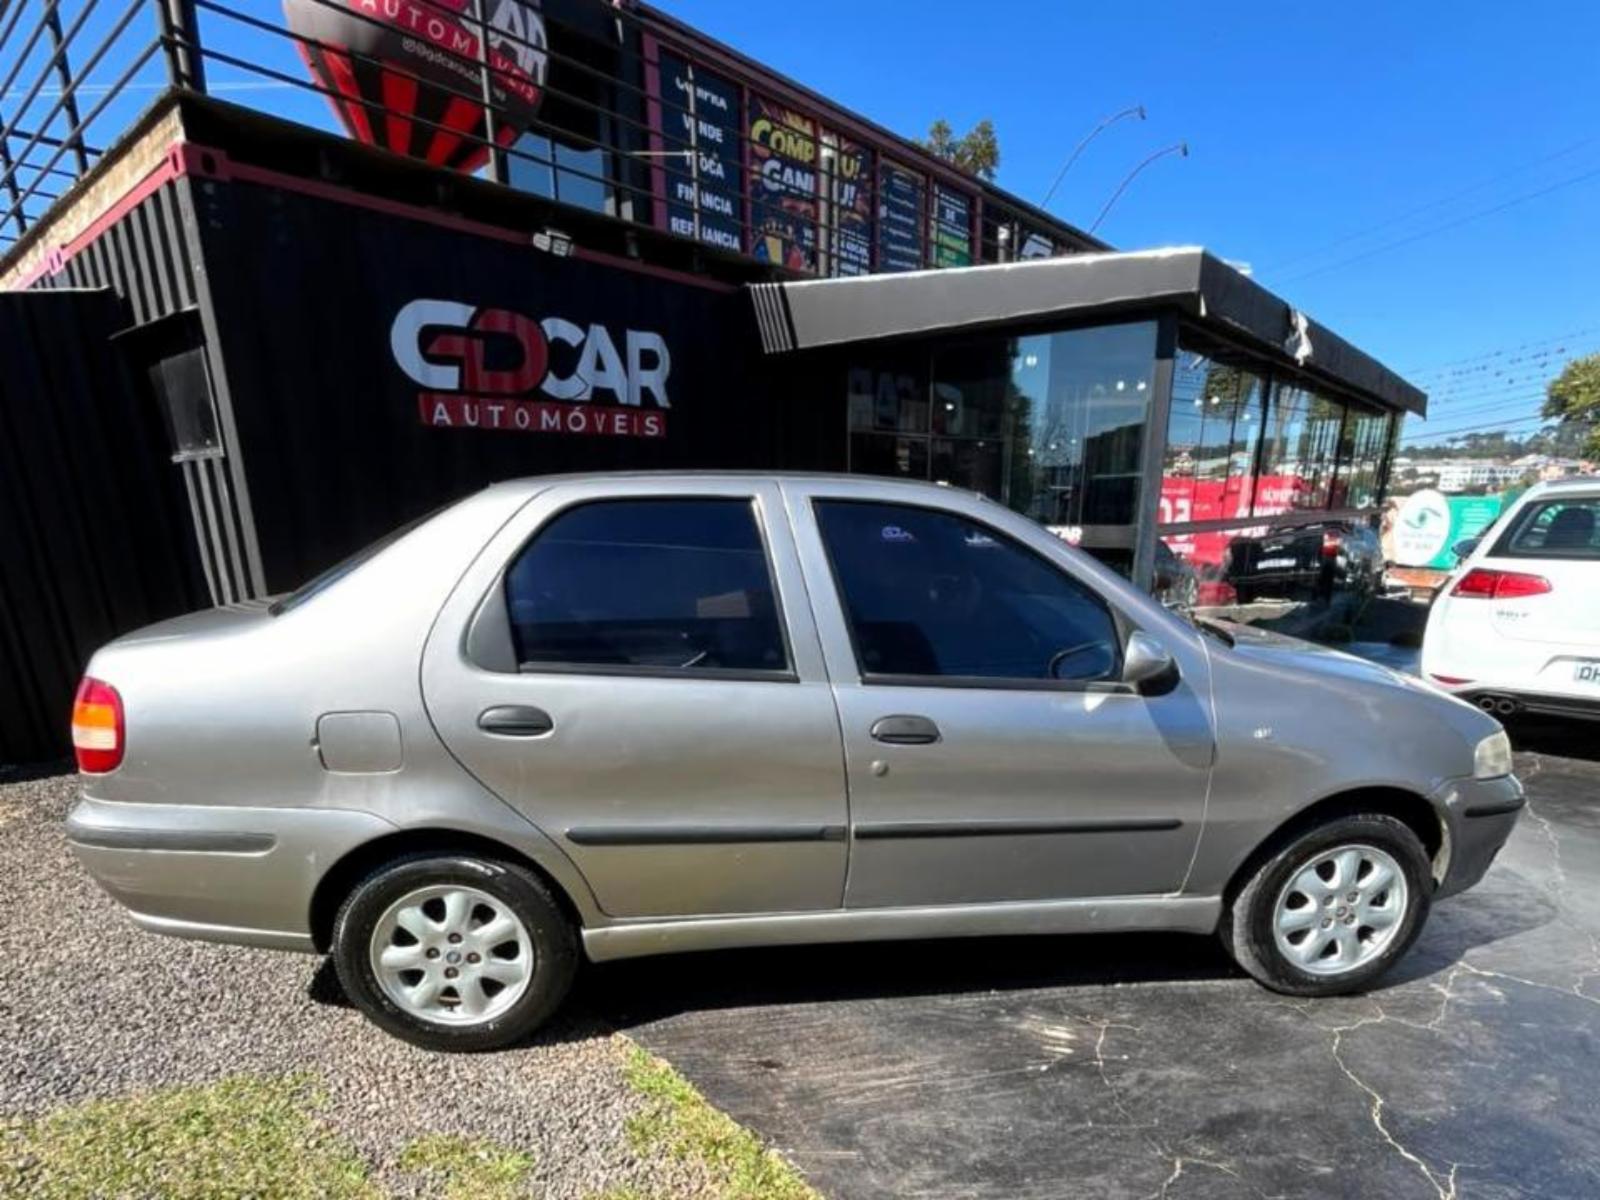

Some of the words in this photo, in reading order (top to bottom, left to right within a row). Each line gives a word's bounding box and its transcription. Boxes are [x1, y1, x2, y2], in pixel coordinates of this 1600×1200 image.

[682, 113, 723, 143] VNDE
[683, 150, 725, 179] TOCA
[390, 298, 671, 408] GDCAR
[431, 402, 660, 436] AUTOMÓVEIS
